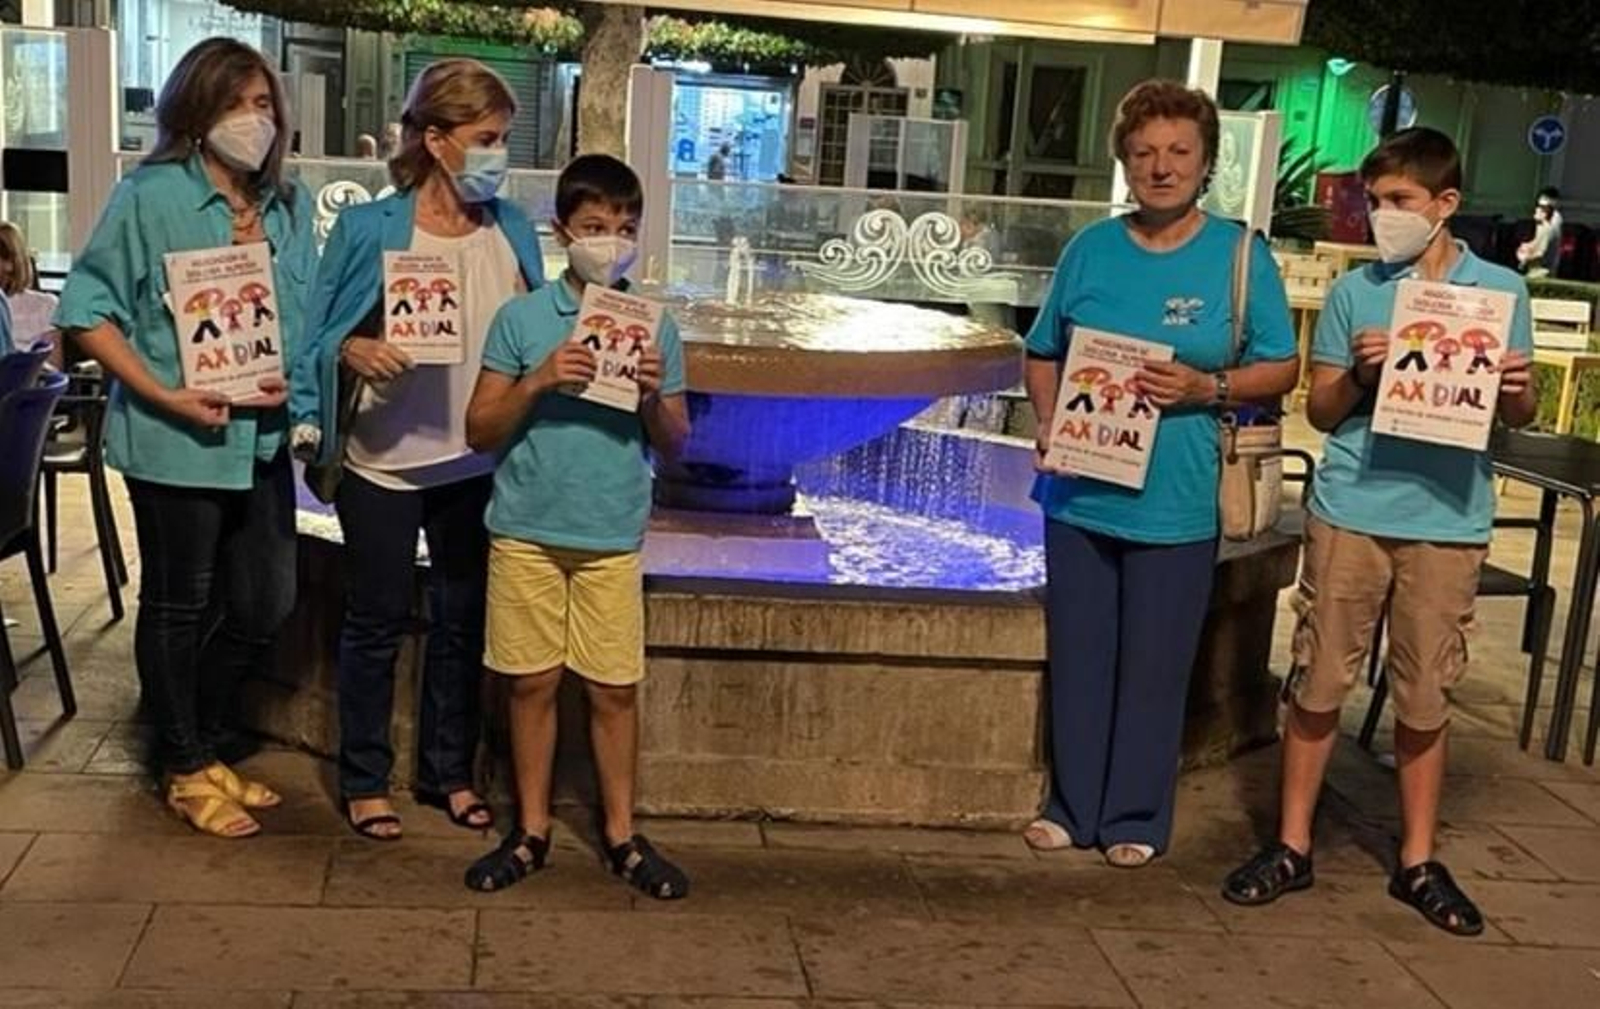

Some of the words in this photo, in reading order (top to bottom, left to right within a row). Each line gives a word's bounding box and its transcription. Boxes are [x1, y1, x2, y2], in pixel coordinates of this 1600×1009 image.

[390, 321, 416, 338] AX
[195, 346, 230, 372] AX
[231, 336, 279, 367] DIAL
[1386, 379, 1426, 403] AX
[1432, 382, 1488, 411] DIAL
[1057, 419, 1092, 442] AX
[1097, 422, 1145, 452] DIAL
